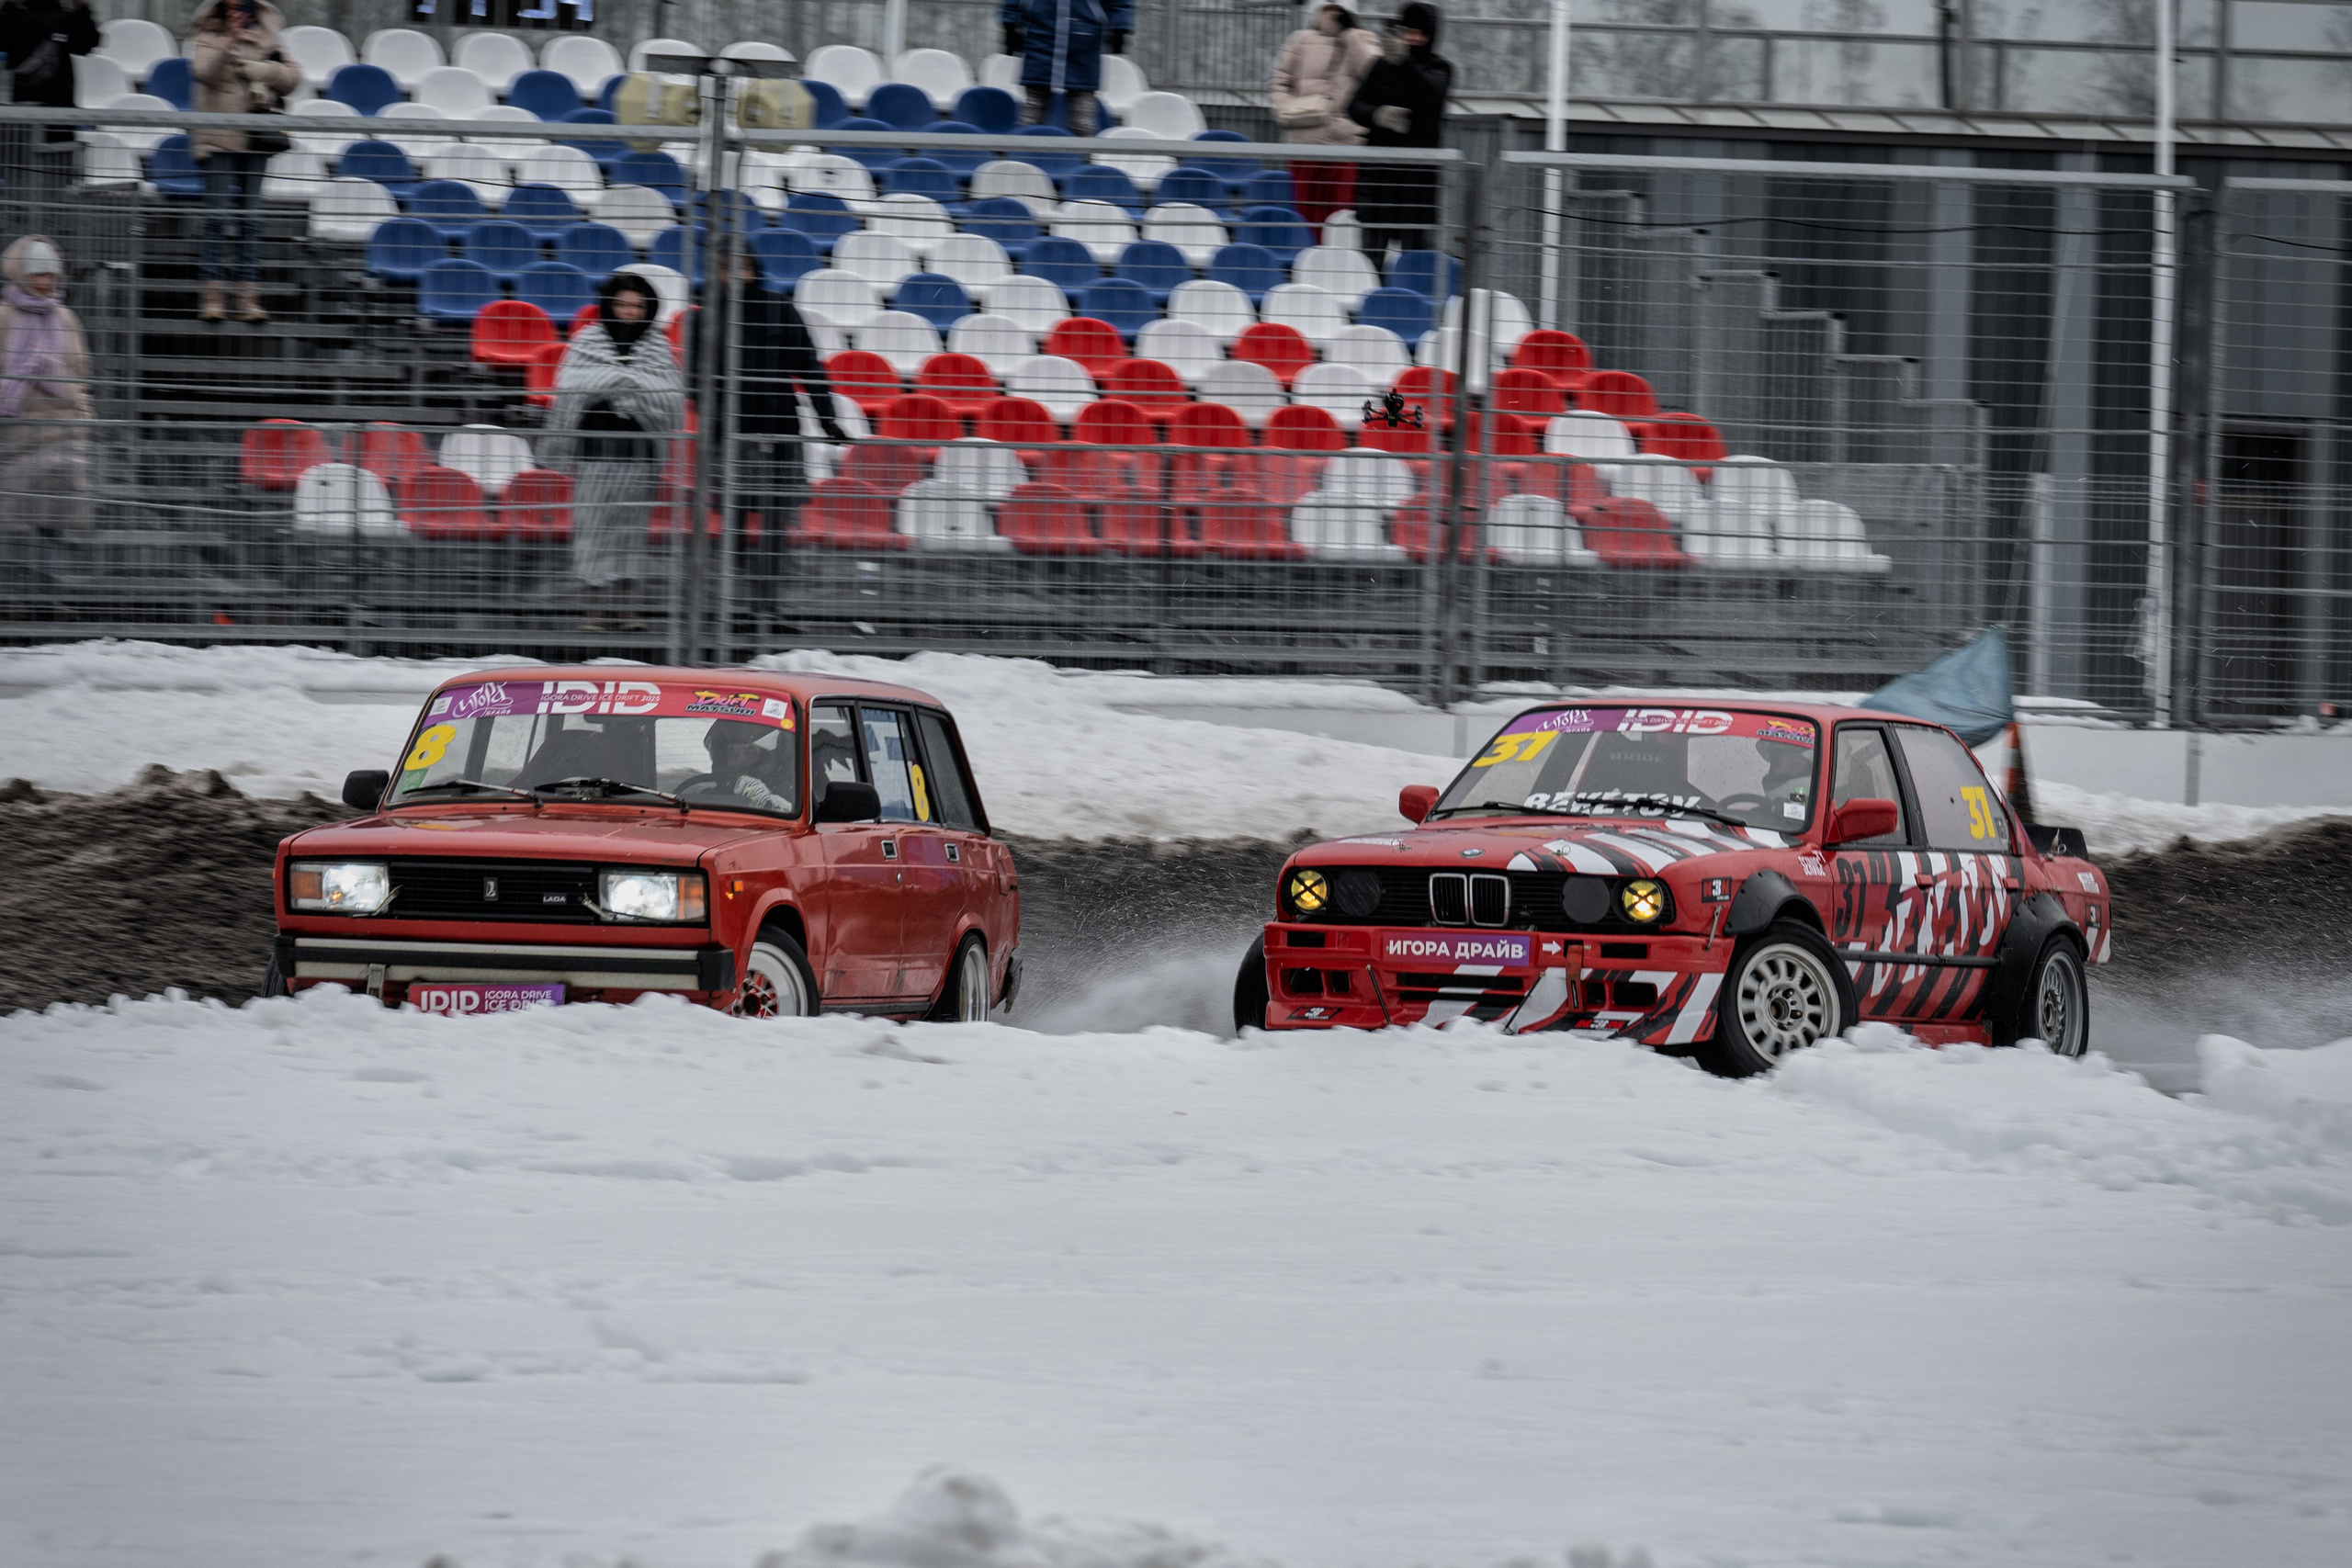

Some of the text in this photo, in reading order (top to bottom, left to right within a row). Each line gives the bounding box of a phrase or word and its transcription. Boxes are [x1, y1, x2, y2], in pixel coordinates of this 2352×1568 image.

[537, 681, 662, 715] IDID
[540, 694, 570, 702] IGORA
[571, 694, 597, 702] DRIVE
[598, 694, 614, 702] ICE
[614, 694, 640, 702] DRIFT
[1617, 709, 1733, 734] IDID
[404, 725, 457, 771] 8
[1472, 731, 1560, 768] 31
[910, 763, 930, 822] 8
[1959, 785, 1996, 840] 31
[1835, 858, 1867, 938] 31
[1389, 940, 1523, 960] ИГОРА ДРАЙВ
[421, 990, 480, 1011] IDID
[485, 990, 552, 999] IGORA DRIVE
[485, 999, 507, 1011] ICE
